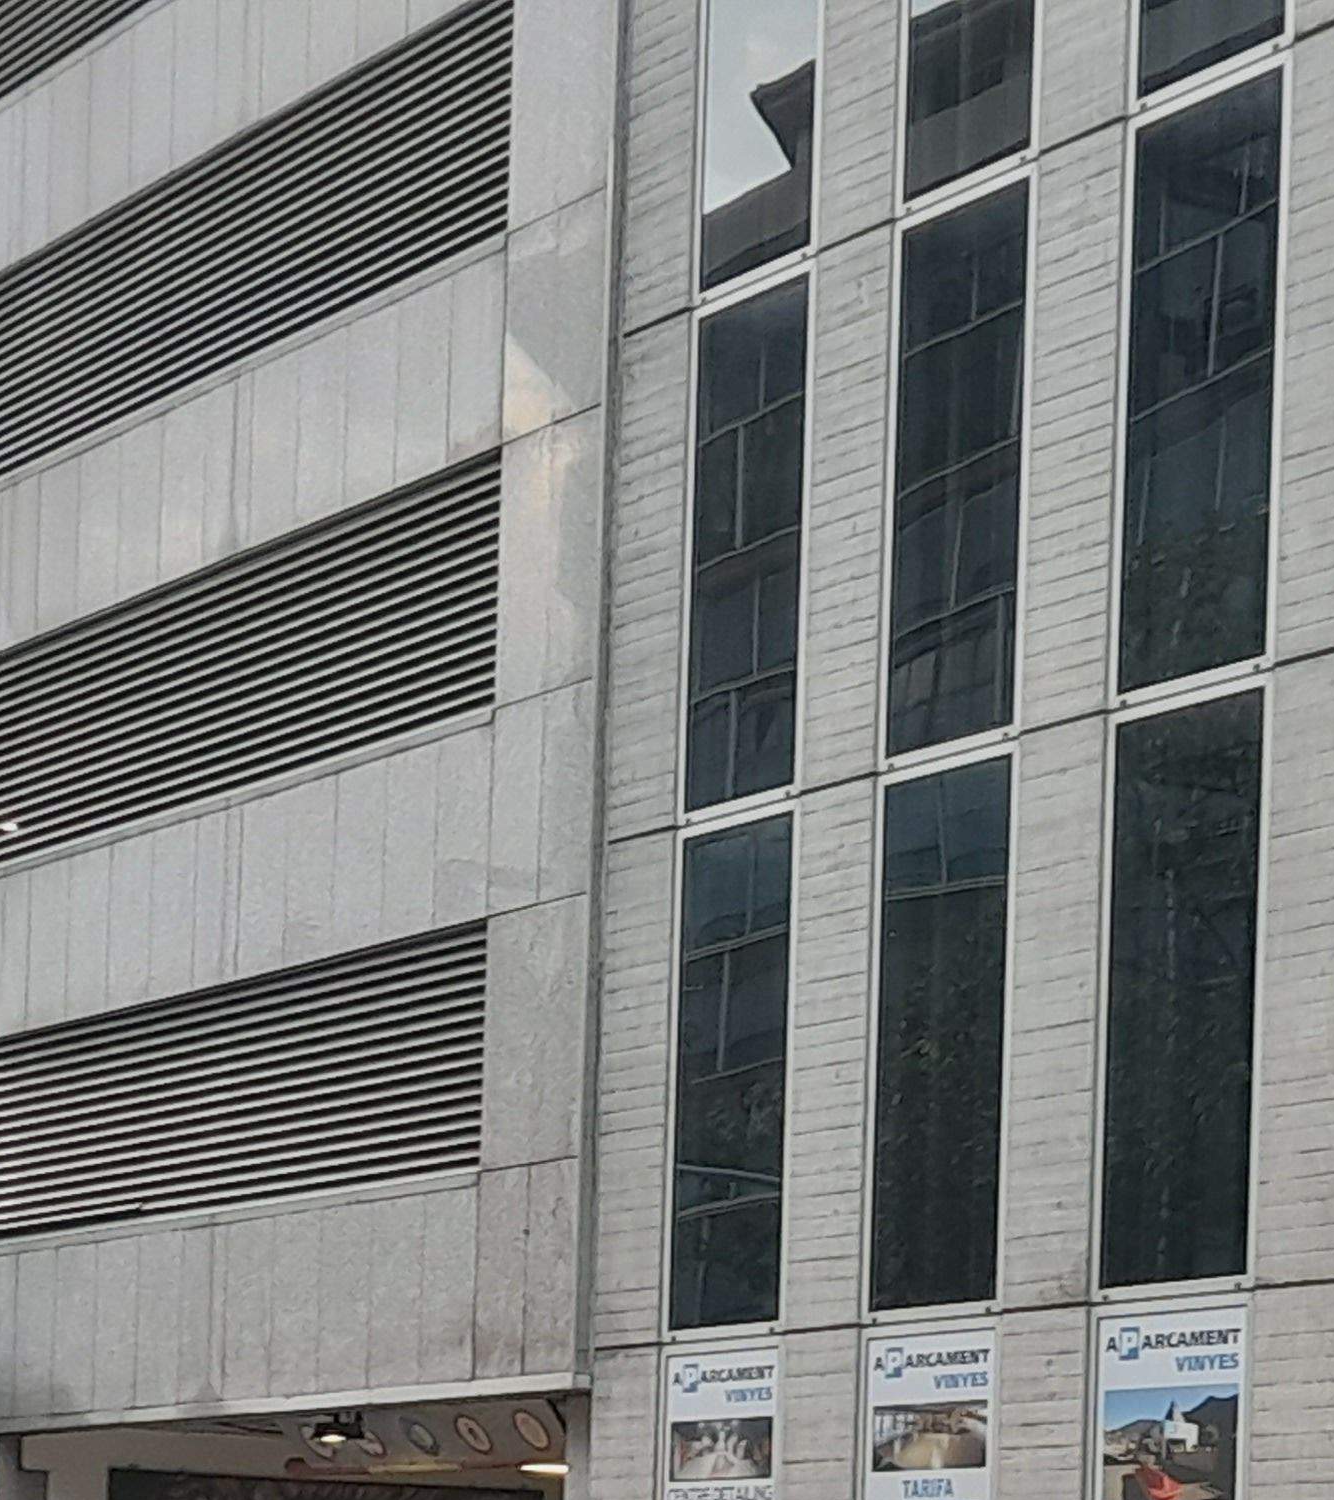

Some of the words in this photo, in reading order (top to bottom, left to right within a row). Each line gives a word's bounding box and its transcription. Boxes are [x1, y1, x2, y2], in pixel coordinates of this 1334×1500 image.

[1105, 1326, 1242, 1361] APARCAMENT
[1175, 1352, 1240, 1373] VINYES
[902, 1478, 954, 1499] TARIFA
